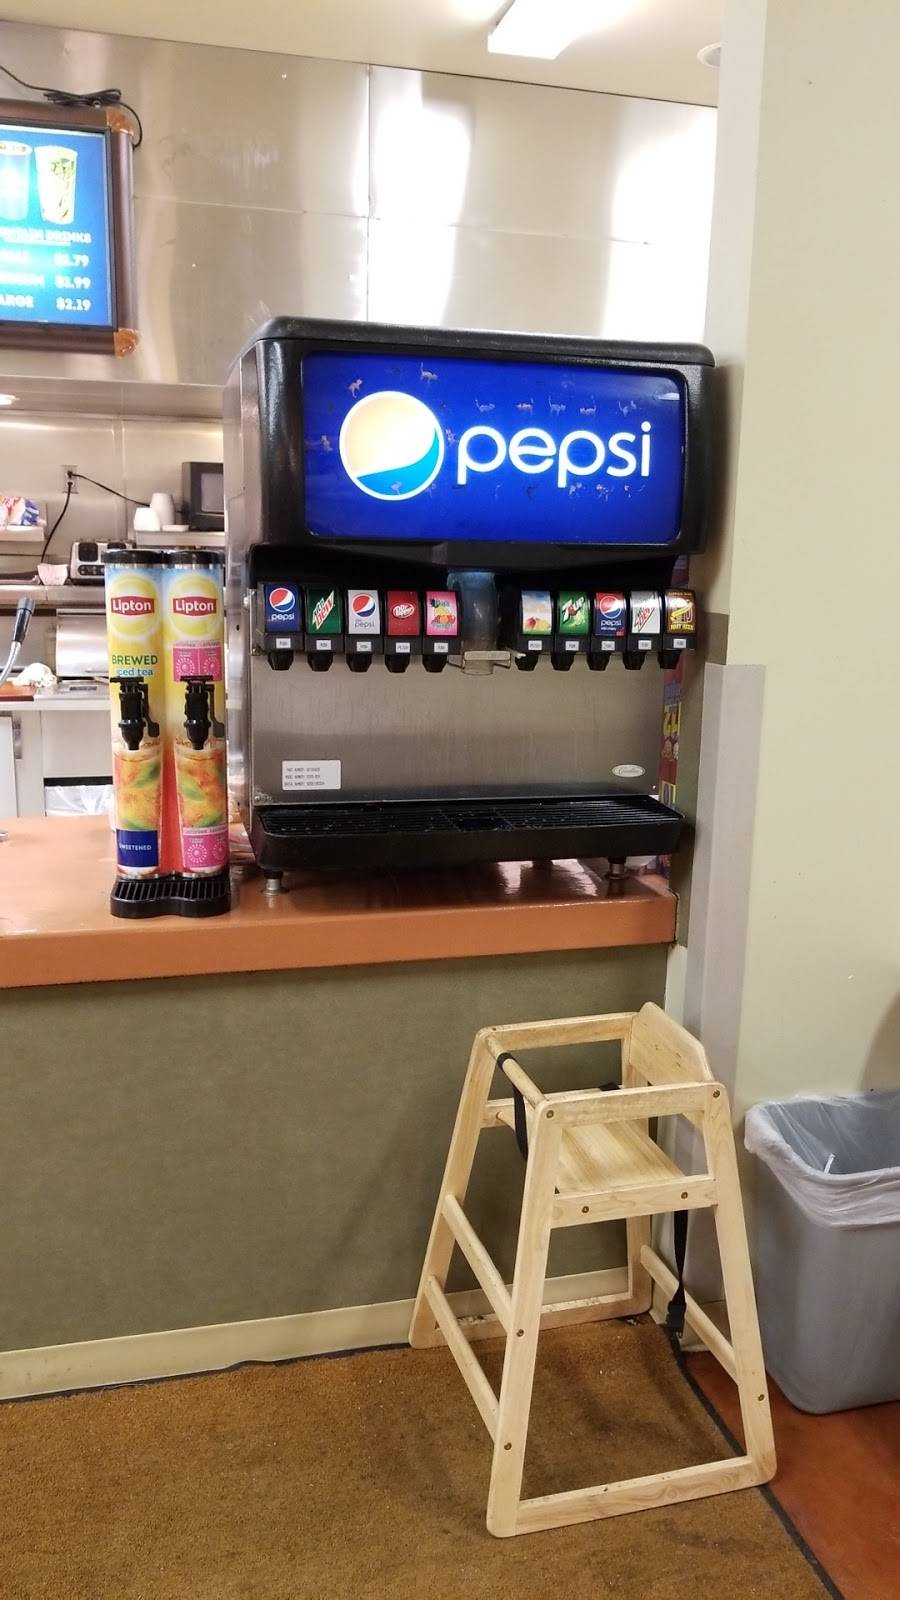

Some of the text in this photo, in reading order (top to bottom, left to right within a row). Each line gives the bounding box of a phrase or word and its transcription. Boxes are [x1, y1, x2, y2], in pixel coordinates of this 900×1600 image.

[56, 297, 91, 310] $2.19
[457, 421, 651, 488] pepsi
[112, 599, 151, 613] Lipton
[174, 599, 214, 613] Lipton
[271, 612, 295, 621] pepsi
[111, 654, 158, 665] BREWED
[116, 668, 153, 676] ced tea
